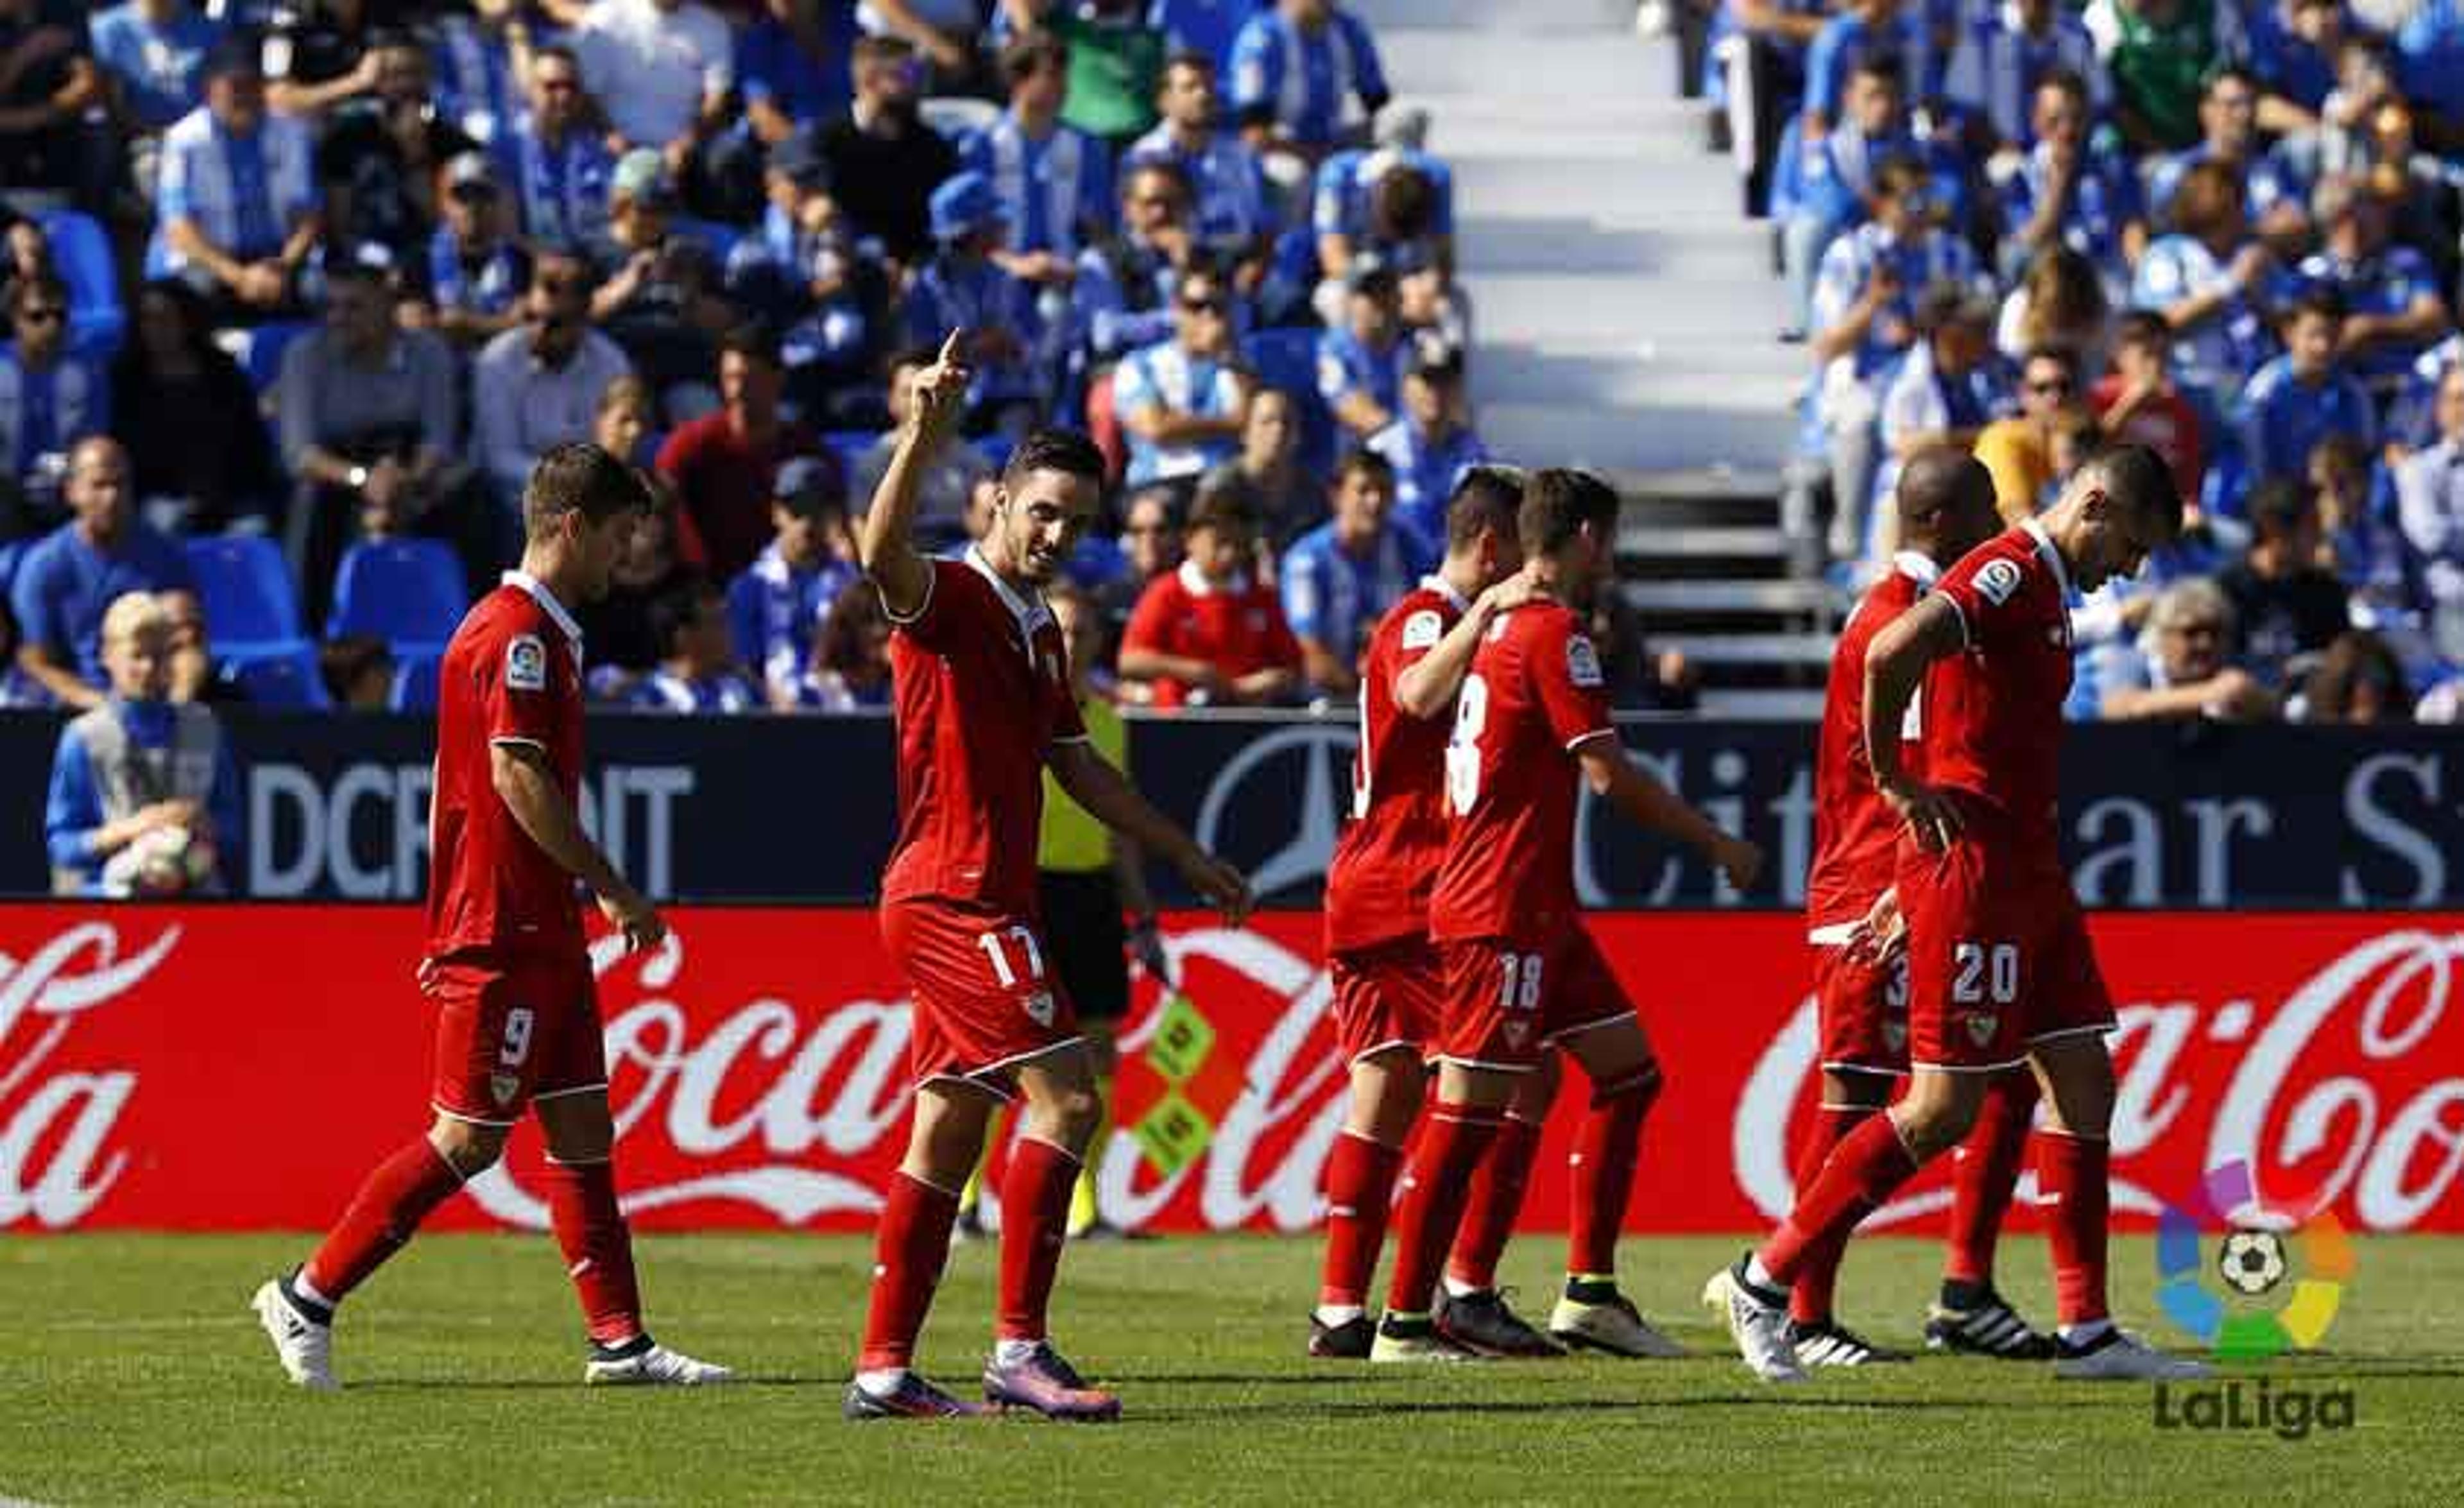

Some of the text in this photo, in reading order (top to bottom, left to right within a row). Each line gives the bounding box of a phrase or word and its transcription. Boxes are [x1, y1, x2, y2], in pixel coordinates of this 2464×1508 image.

[2341, 752, 2464, 906] S
[978, 926, 1044, 988] 17
[1500, 953, 1542, 1008] 18
[1953, 943, 2019, 1003] 20
[500, 1007, 533, 1067] 9
